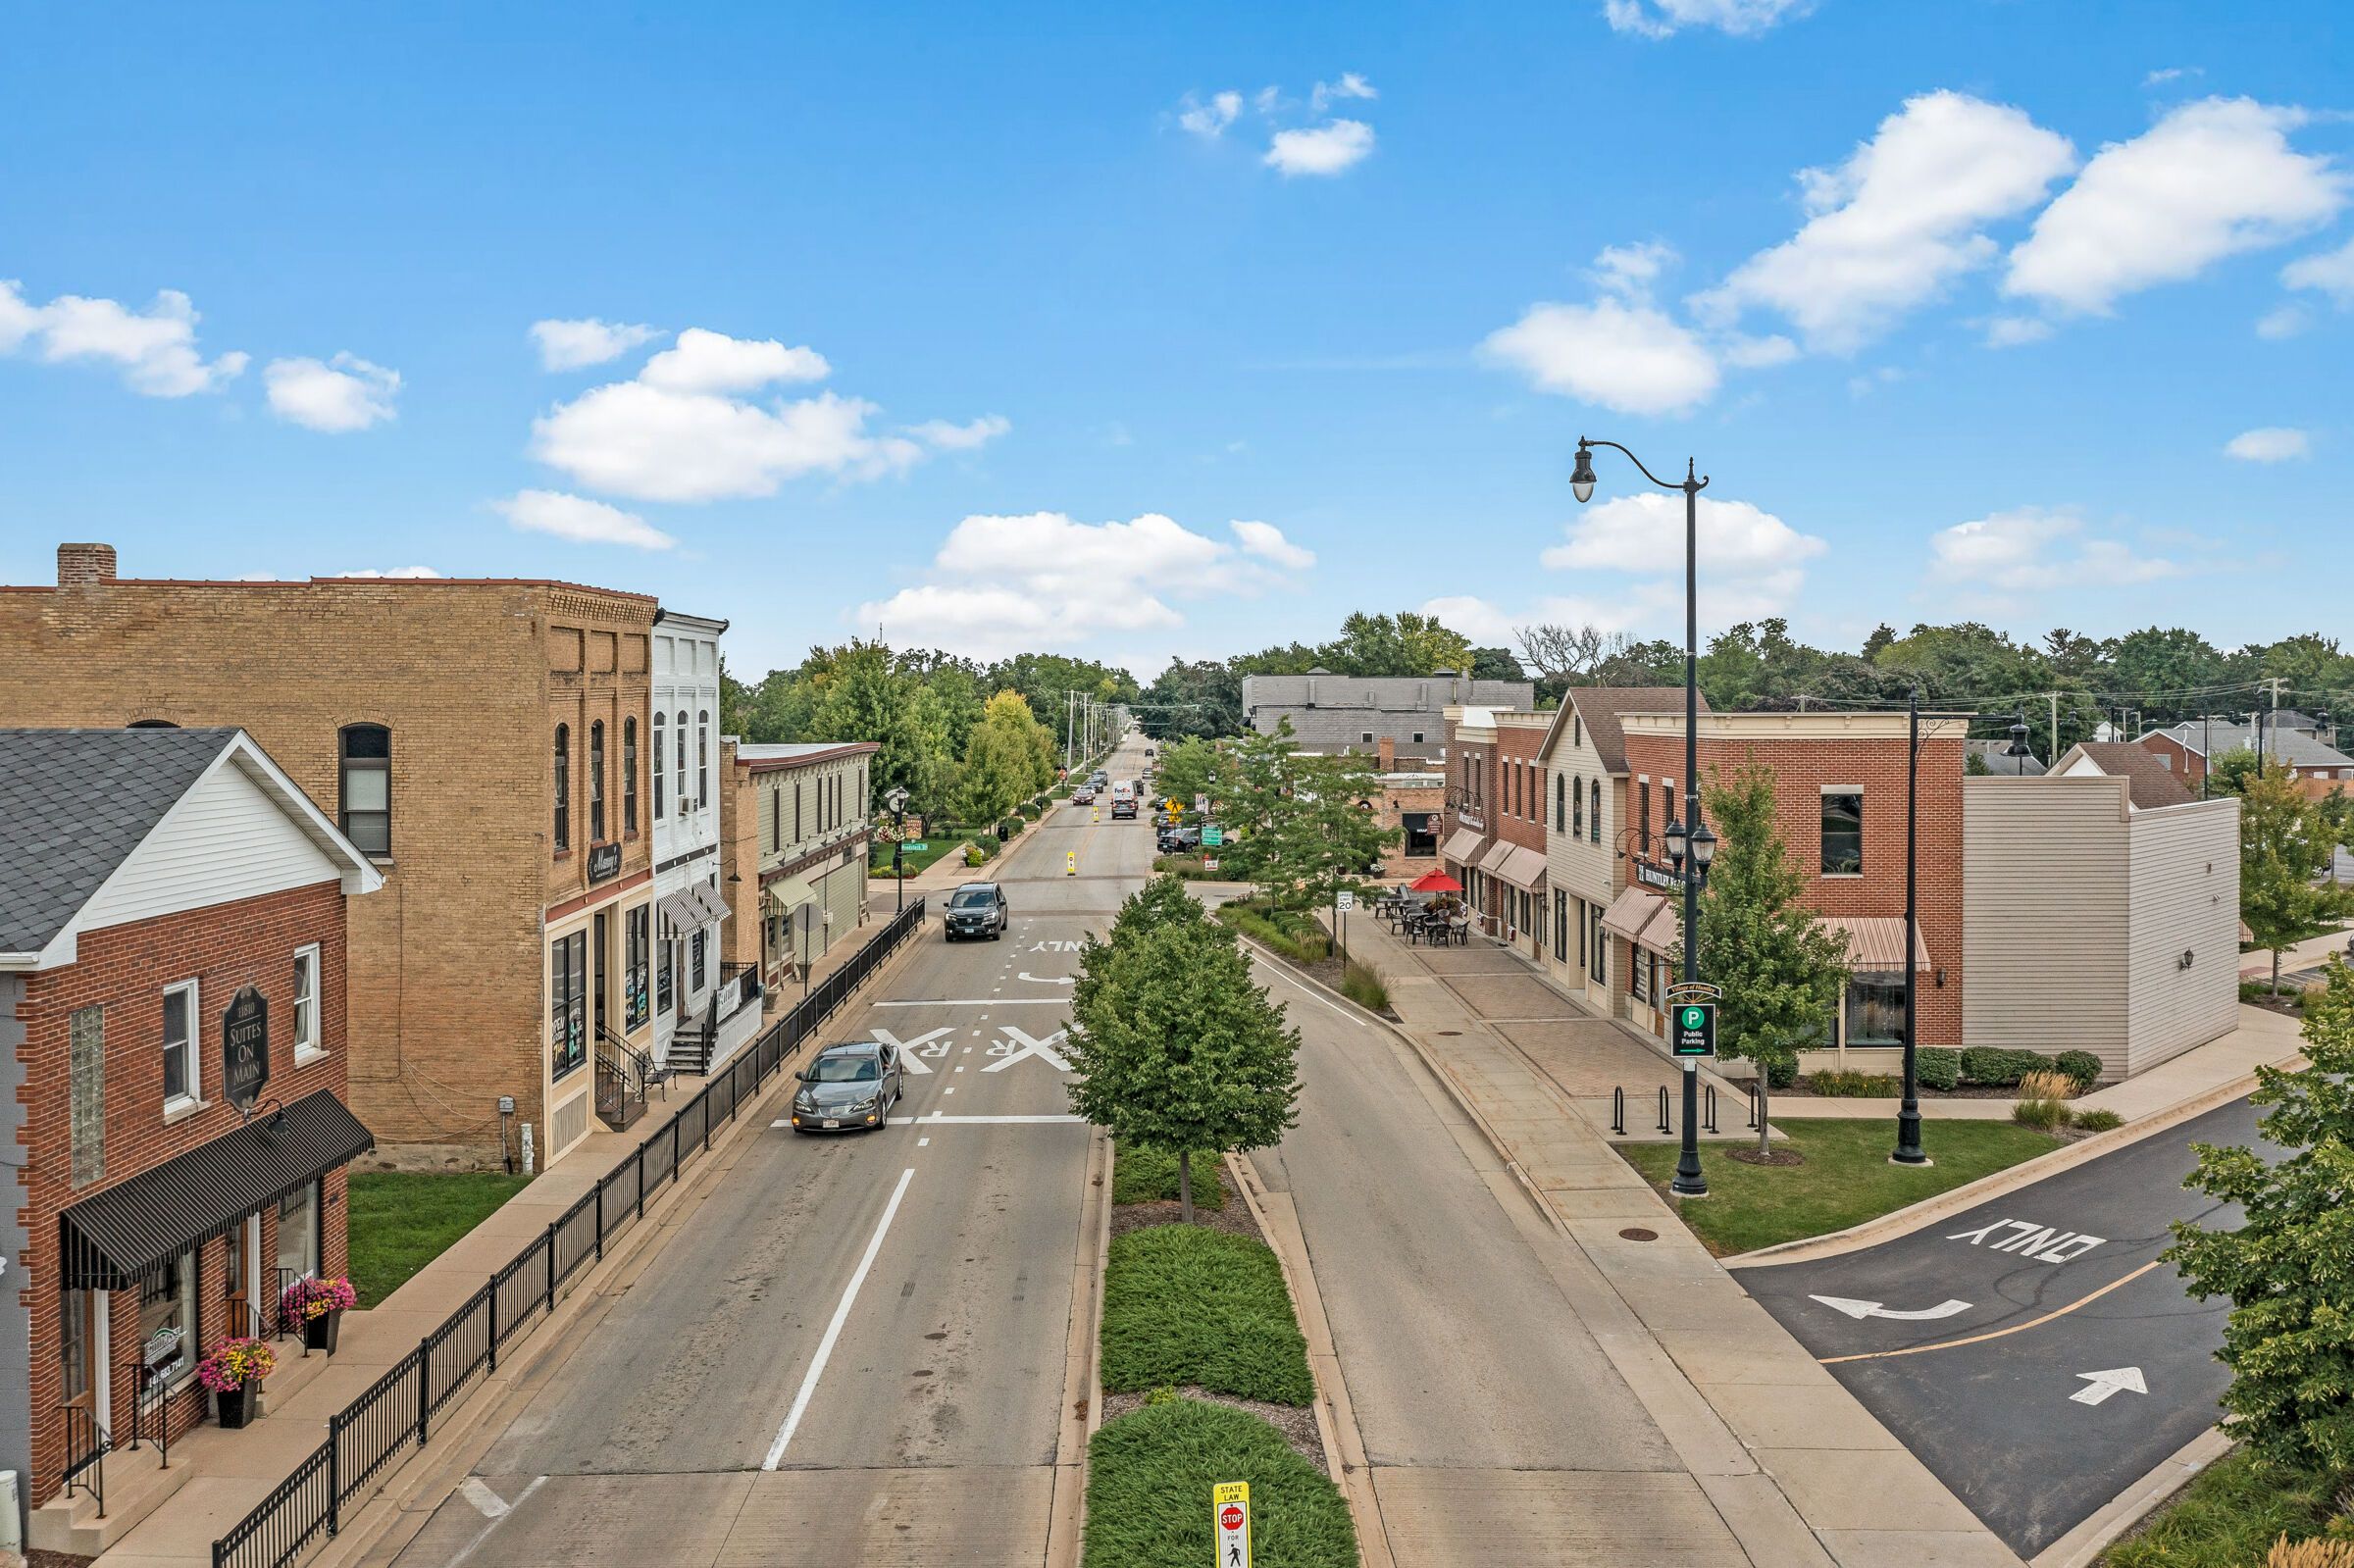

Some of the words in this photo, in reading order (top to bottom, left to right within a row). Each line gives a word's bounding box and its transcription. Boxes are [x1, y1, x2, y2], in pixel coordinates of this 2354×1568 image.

[1695, 985, 1715, 993] Huntley
[237, 1002, 255, 1018] 11810
[1689, 1011, 1699, 1025] P
[230, 1022, 262, 1047] SUITES
[233, 1061, 260, 1086] MAIN
[1946, 1218, 2108, 1264] ONLY
[1222, 1513, 1243, 1524] STOP
